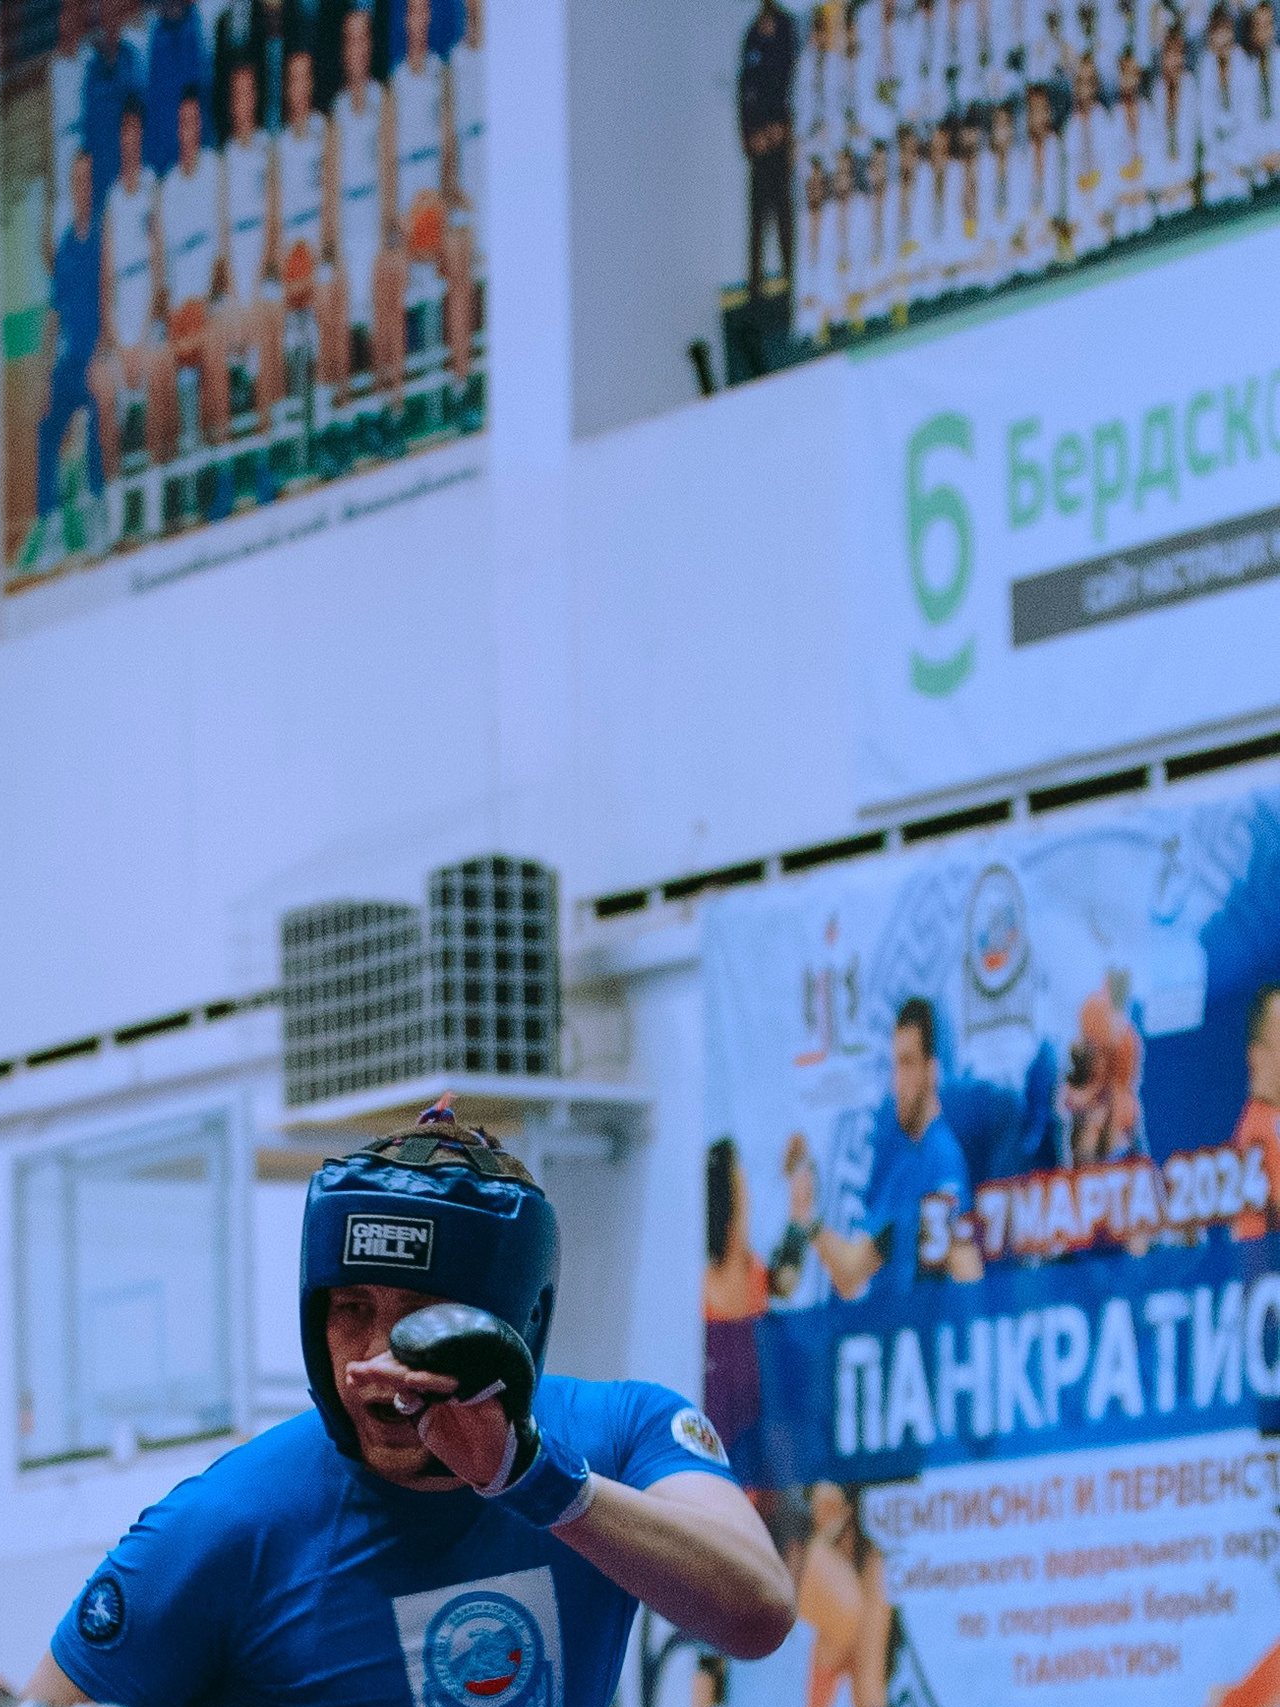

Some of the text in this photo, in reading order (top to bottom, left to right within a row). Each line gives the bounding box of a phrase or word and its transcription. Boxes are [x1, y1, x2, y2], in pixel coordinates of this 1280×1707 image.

[1014, 1164, 1158, 1245] МАРТА
[1163, 1147, 1270, 1224] 2024
[352, 1222, 428, 1244] GREEN
[352, 1239, 415, 1260] HILL
